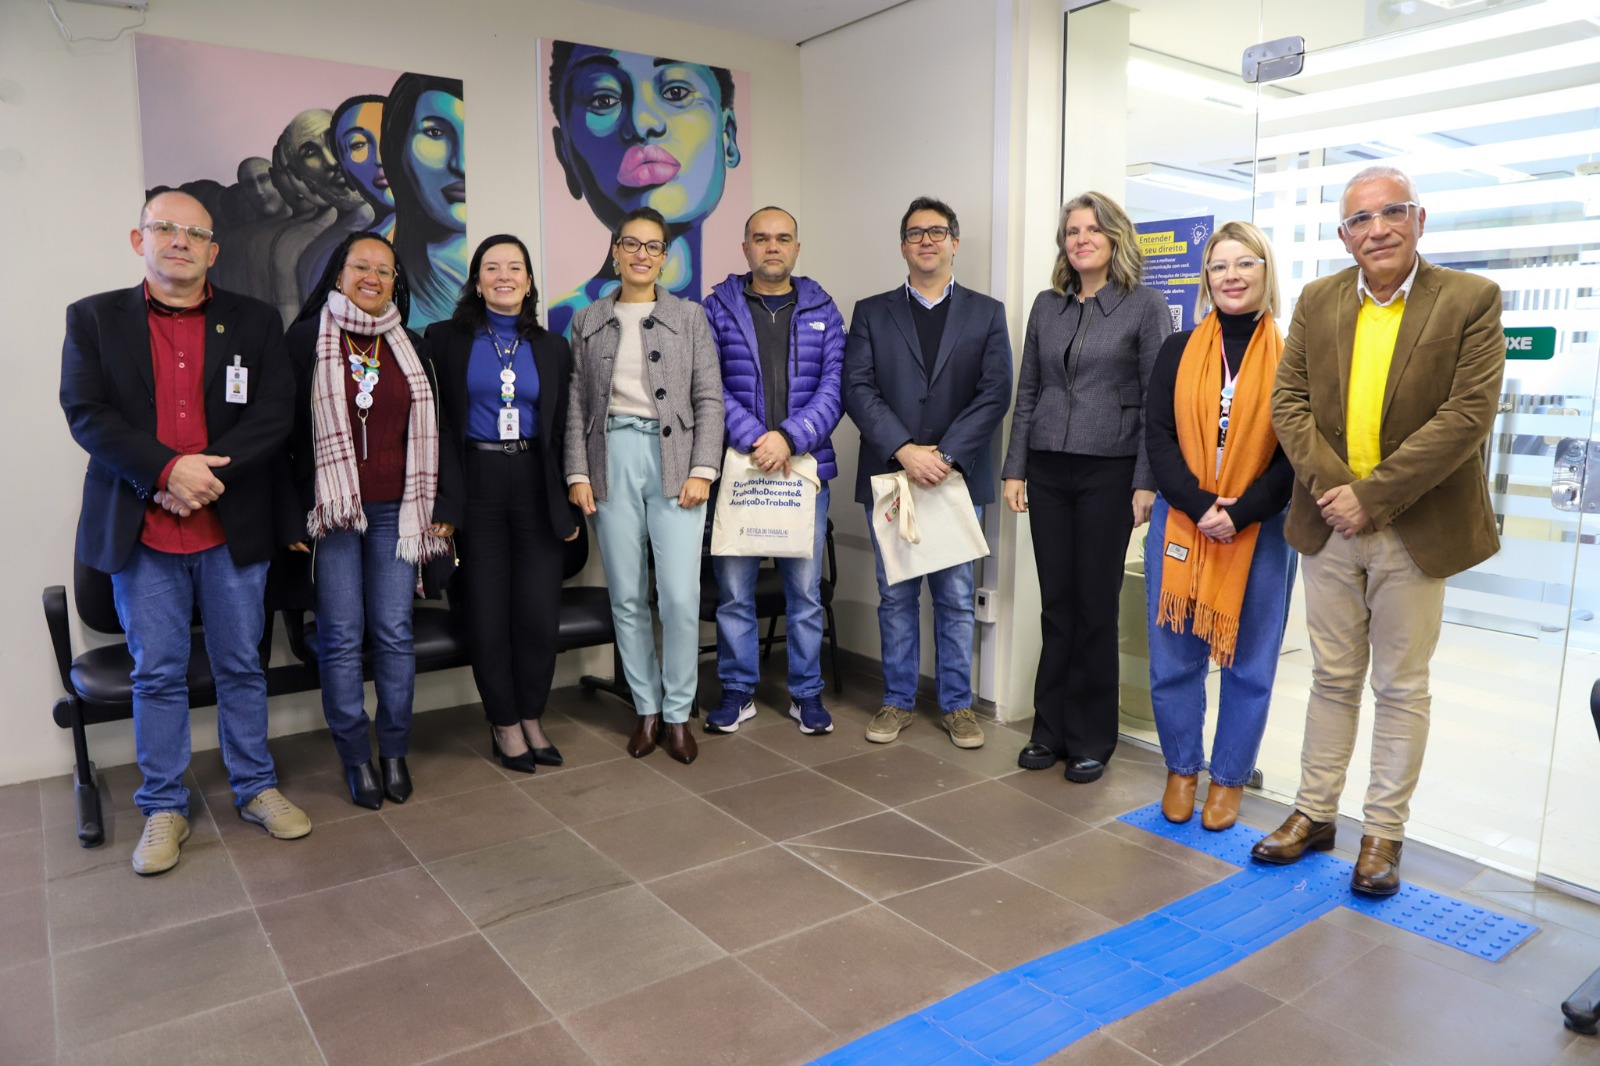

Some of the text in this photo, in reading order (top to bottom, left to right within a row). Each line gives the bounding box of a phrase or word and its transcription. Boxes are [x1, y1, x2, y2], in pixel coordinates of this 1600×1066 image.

[1140, 235, 1172, 244] Entender
[1159, 244, 1186, 253] direito.
[729, 498, 800, 507] JustiçaDoTrabalho
